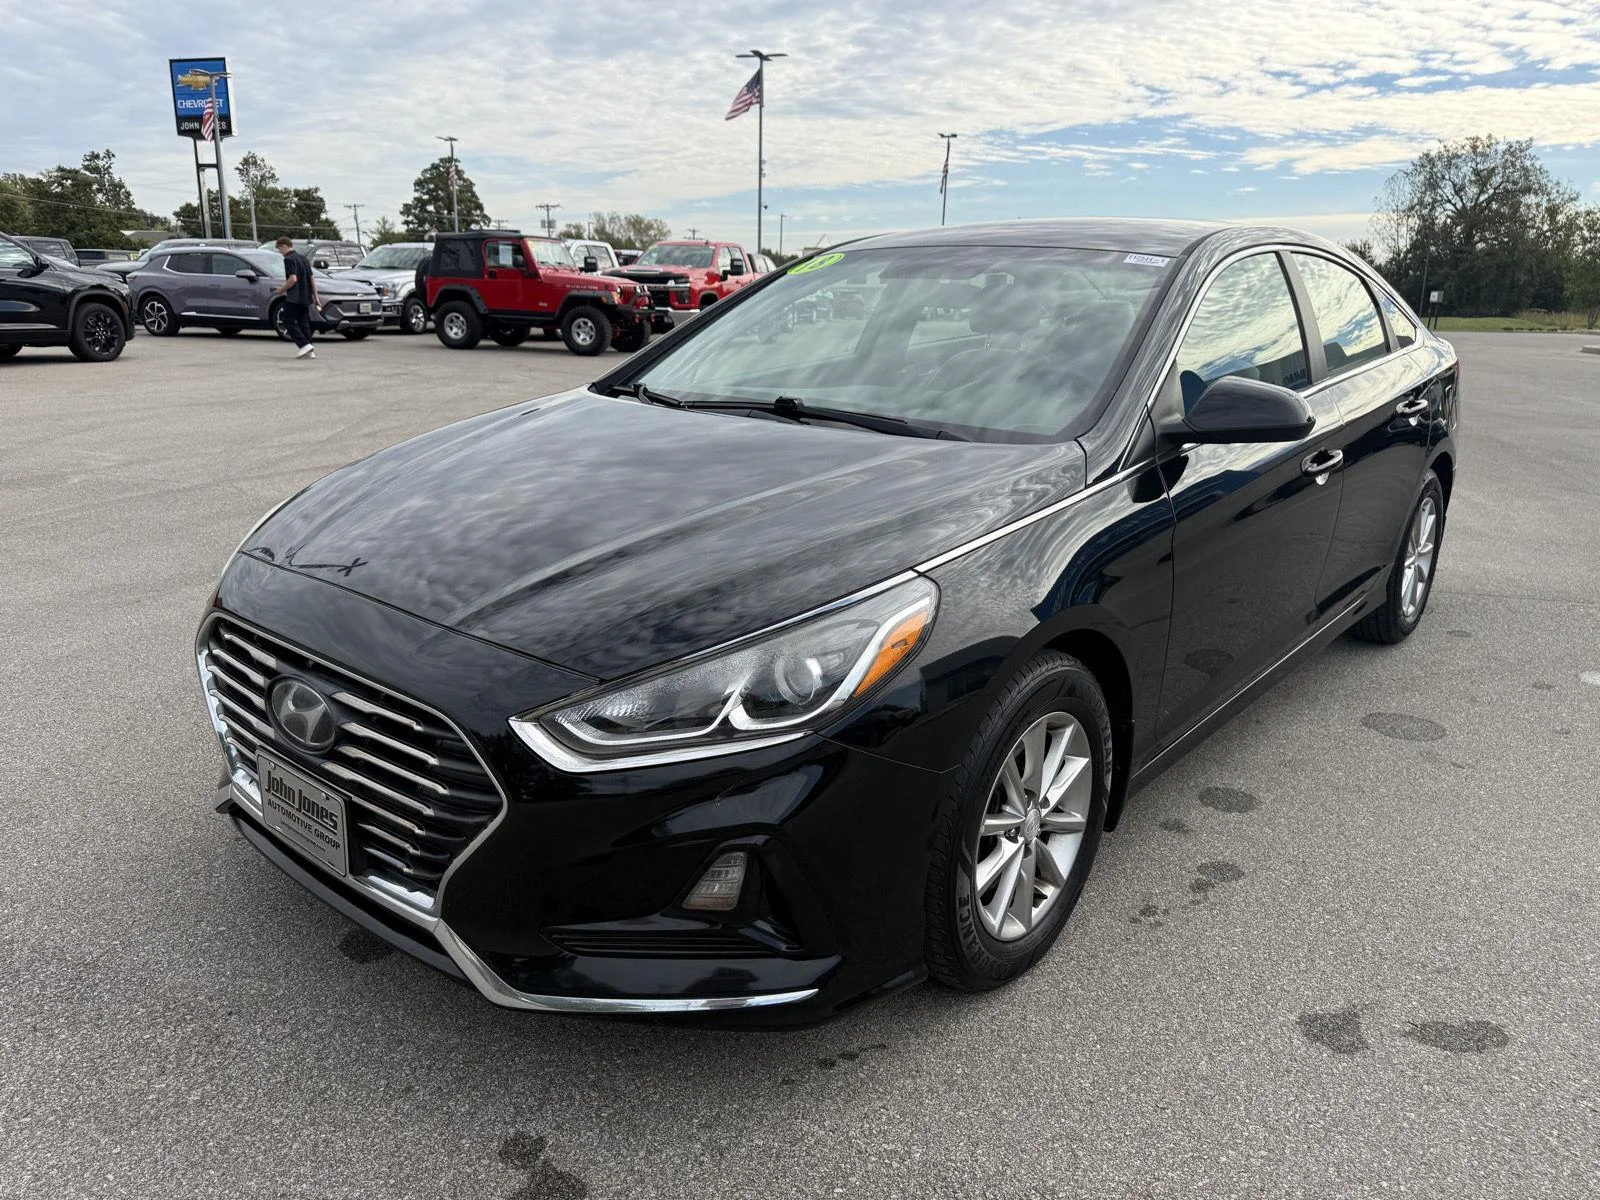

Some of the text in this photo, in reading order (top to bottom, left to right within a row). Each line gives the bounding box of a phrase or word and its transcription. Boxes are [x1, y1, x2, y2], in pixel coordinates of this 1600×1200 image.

[177, 99, 224, 109] CHEVRET
[181, 121, 200, 130] JOHN
[265, 769, 339, 831] John Jones
[267, 798, 313, 834] AUTOMOTIVE
[314, 827, 341, 850] GROUP
